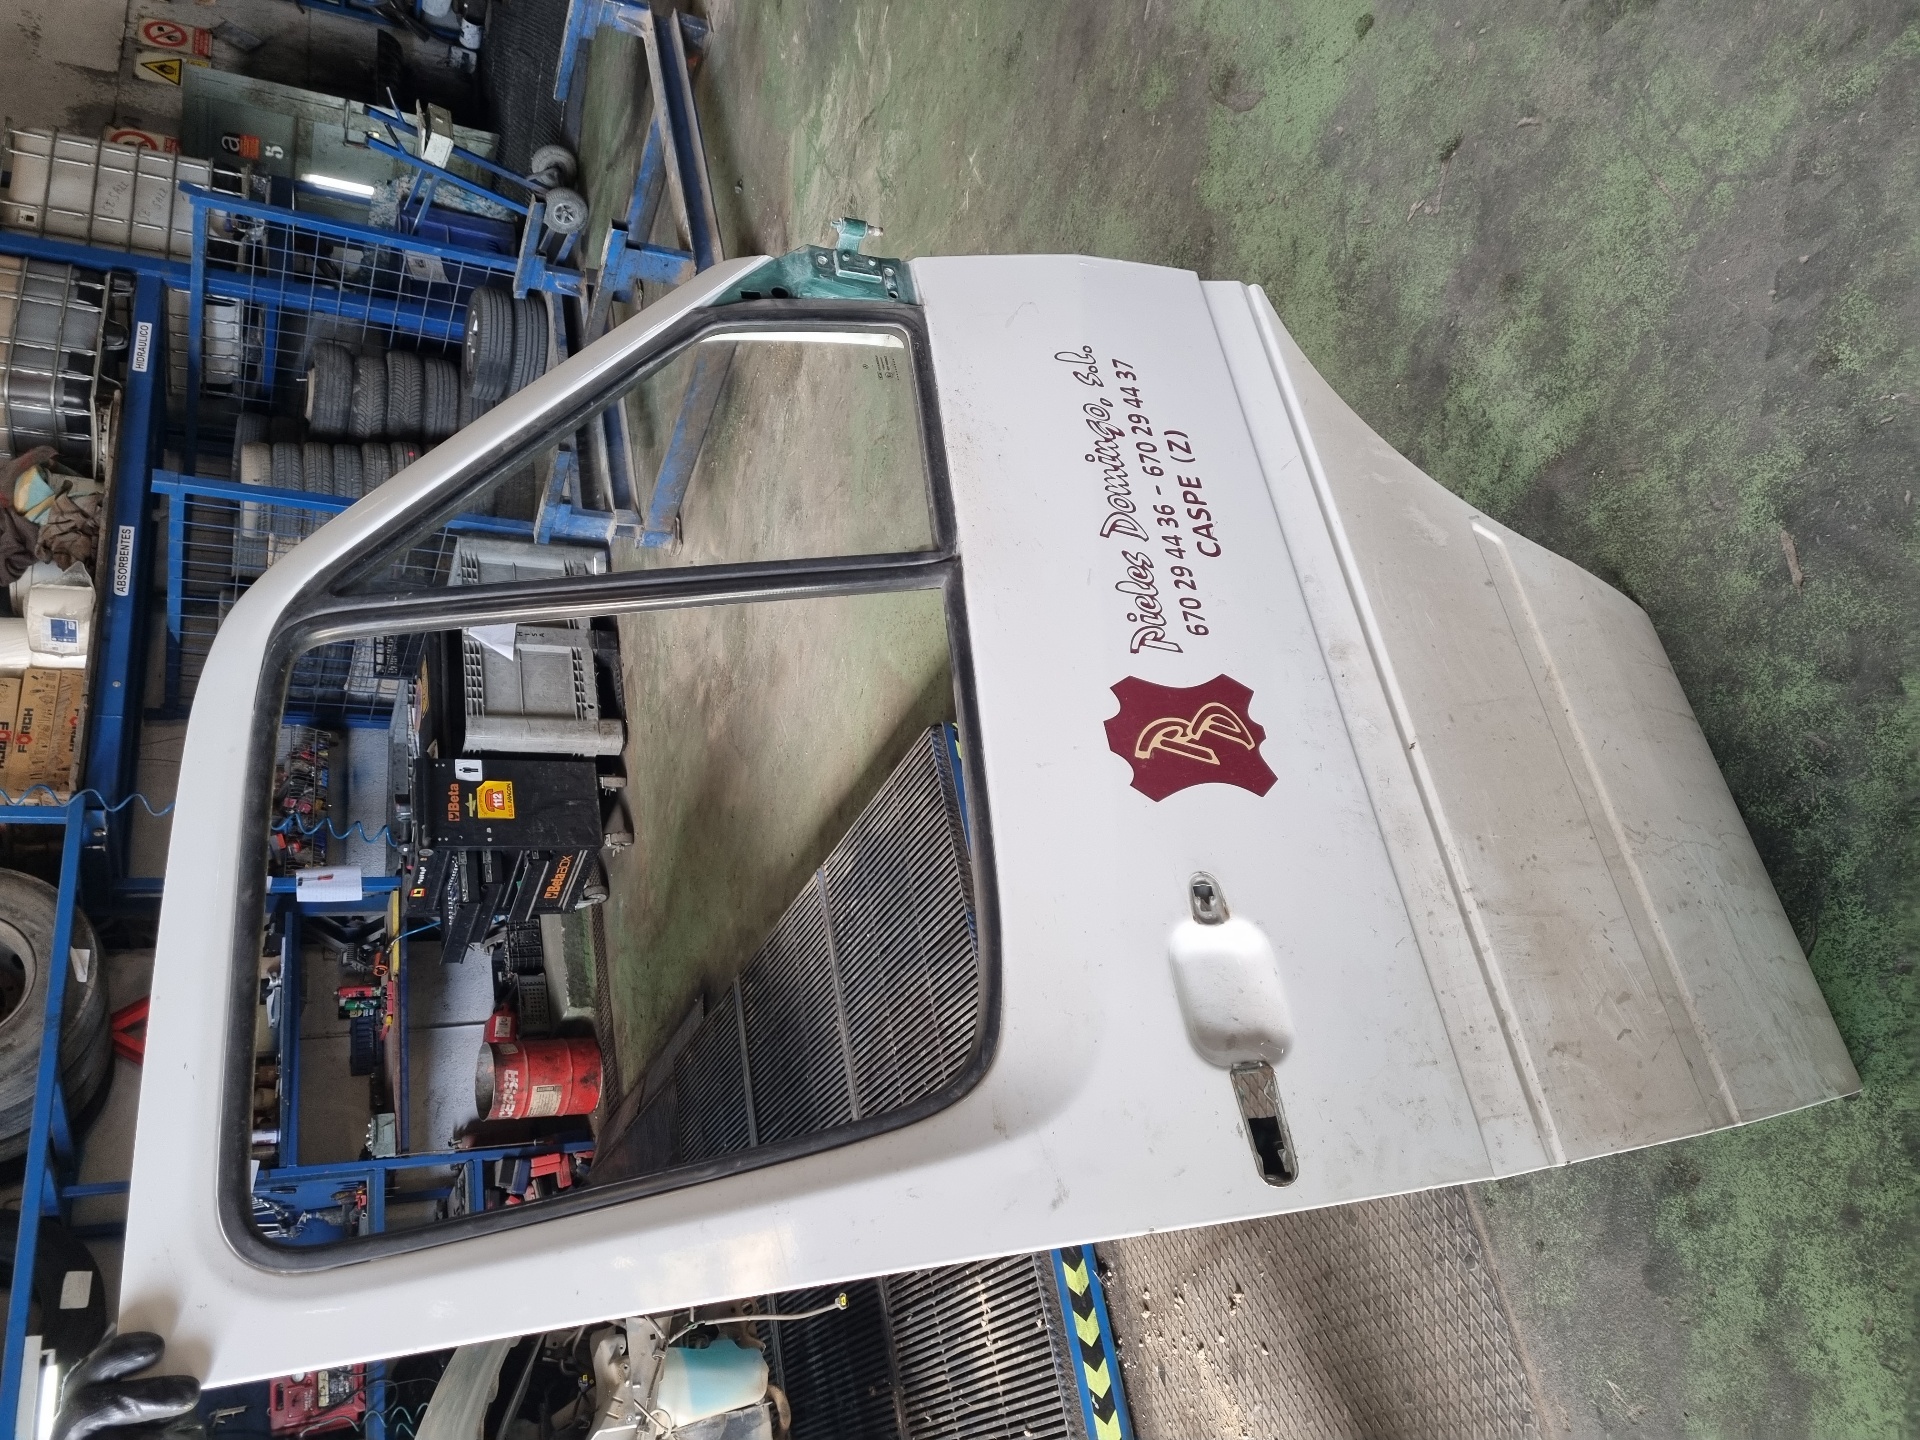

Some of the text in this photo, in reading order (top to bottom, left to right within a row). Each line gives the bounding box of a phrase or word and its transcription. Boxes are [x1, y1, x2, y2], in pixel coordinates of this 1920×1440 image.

[264, 145, 284, 160] 5
[135, 324, 149, 370] HIDRAULICO
[1112, 359, 1136, 381] 37
[1120, 387, 1143, 408] 44
[1128, 414, 1153, 436] 29
[1083, 398, 1149, 542] Domingo,
[1136, 442, 1164, 476] 670
[1164, 430, 1221, 557] CASPE (Z)
[1153, 505, 1179, 528] 36
[116, 528, 132, 592] ABSORBENTES
[1162, 535, 1187, 559] 44
[1170, 566, 1197, 590] 29
[1115, 550, 1183, 654] Pieles
[1179, 598, 1209, 635] 670
[448, 783, 460, 812] Beta
[492, 793, 503, 808] 112
[498, 1070, 519, 1118] CEPSA
